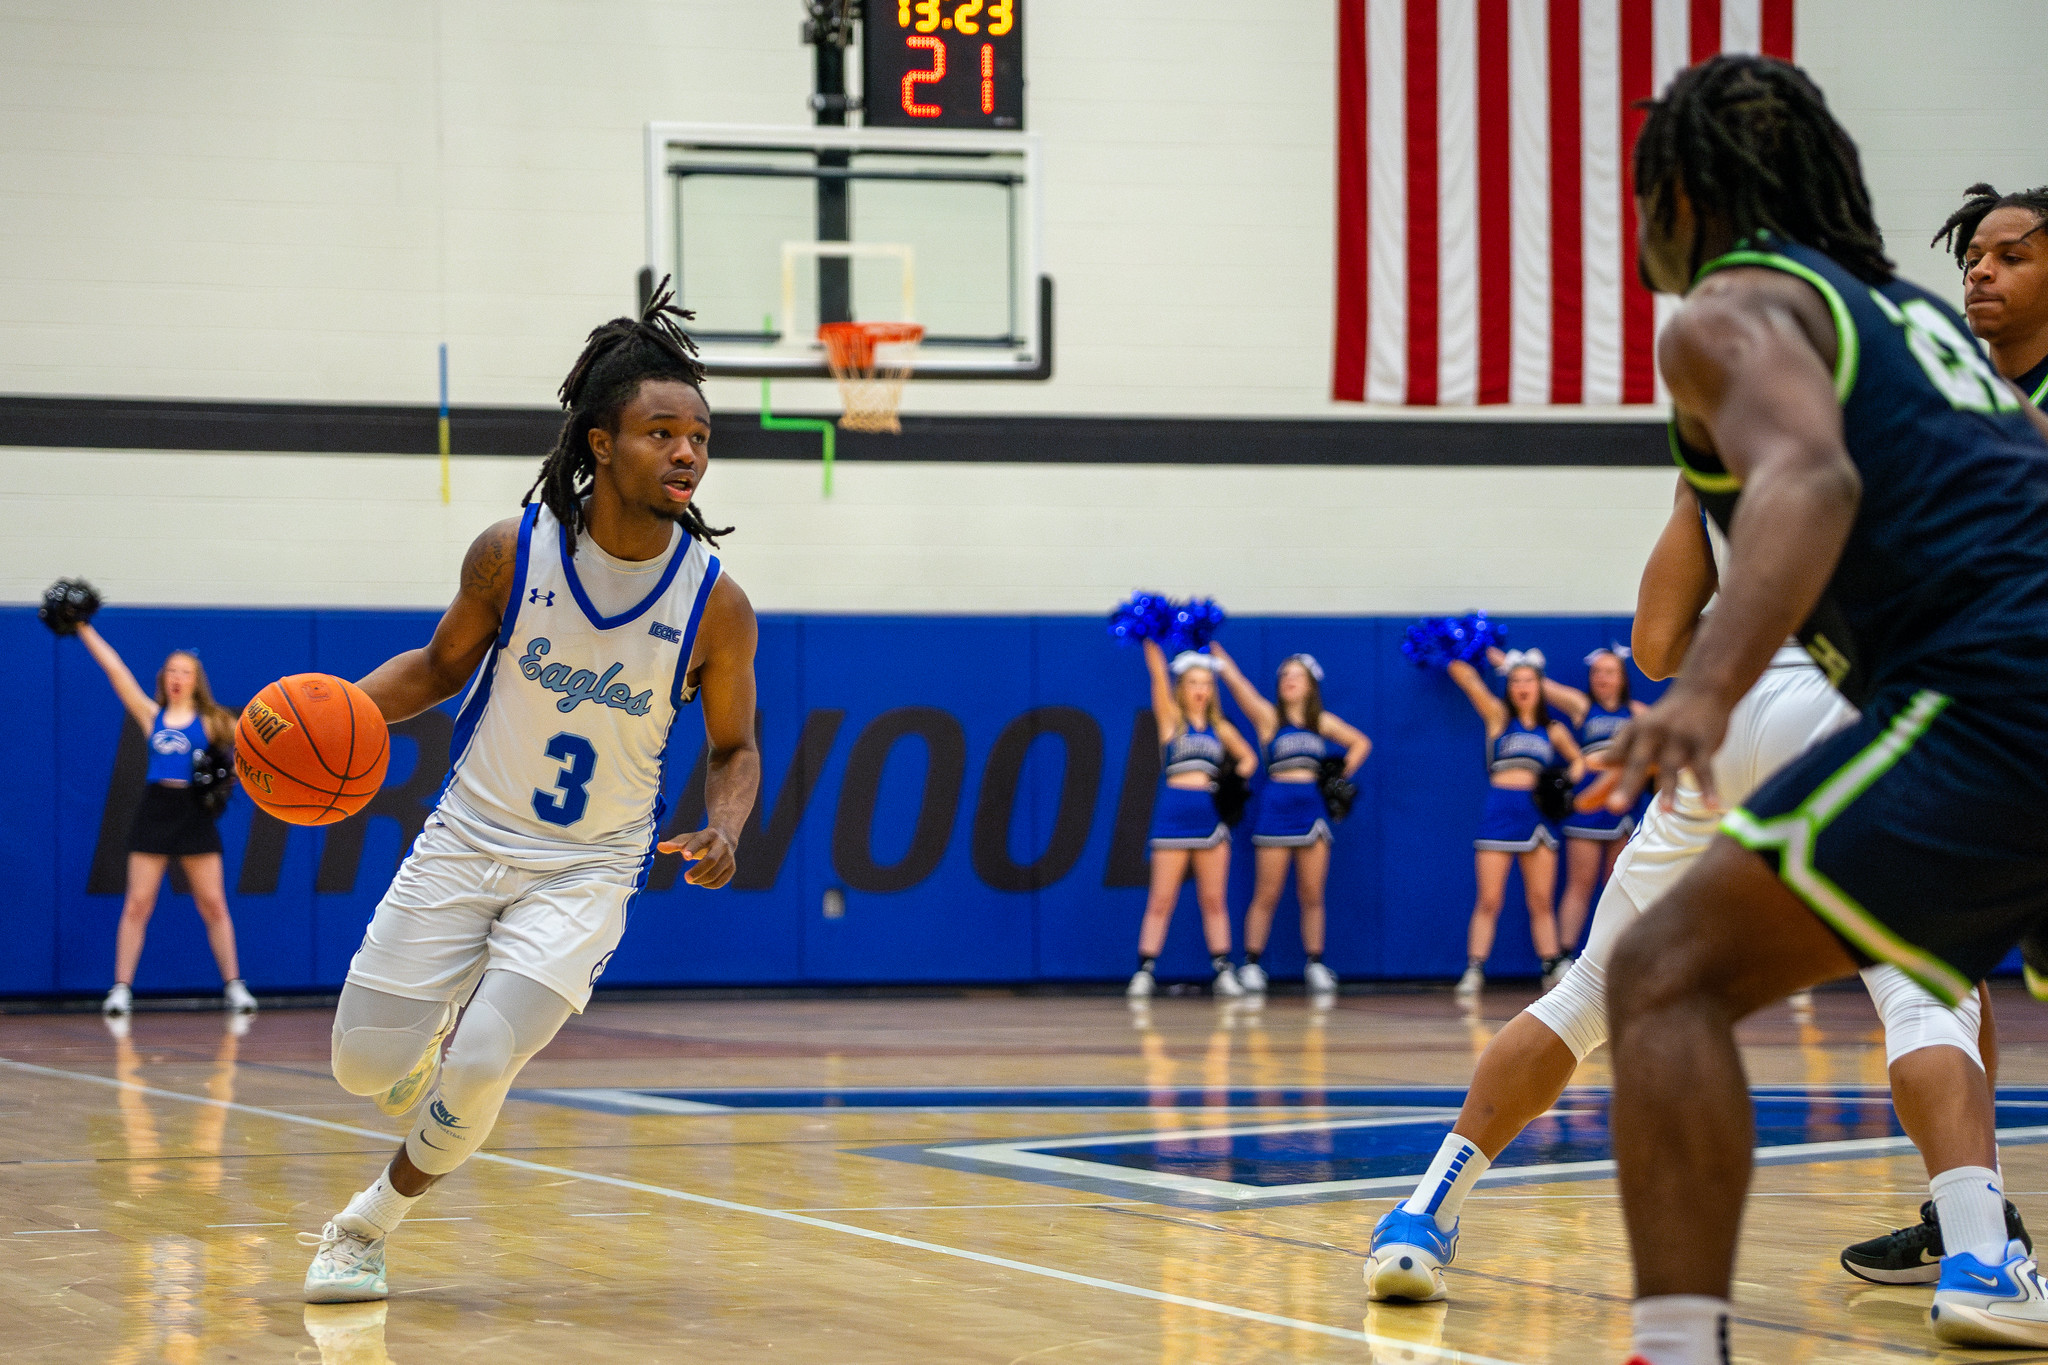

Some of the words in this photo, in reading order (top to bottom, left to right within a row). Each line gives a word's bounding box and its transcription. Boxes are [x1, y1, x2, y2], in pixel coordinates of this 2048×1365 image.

[518, 637, 653, 716] Eagles
[531, 730, 599, 828] 3
[435, 1099, 461, 1125] NIKE
